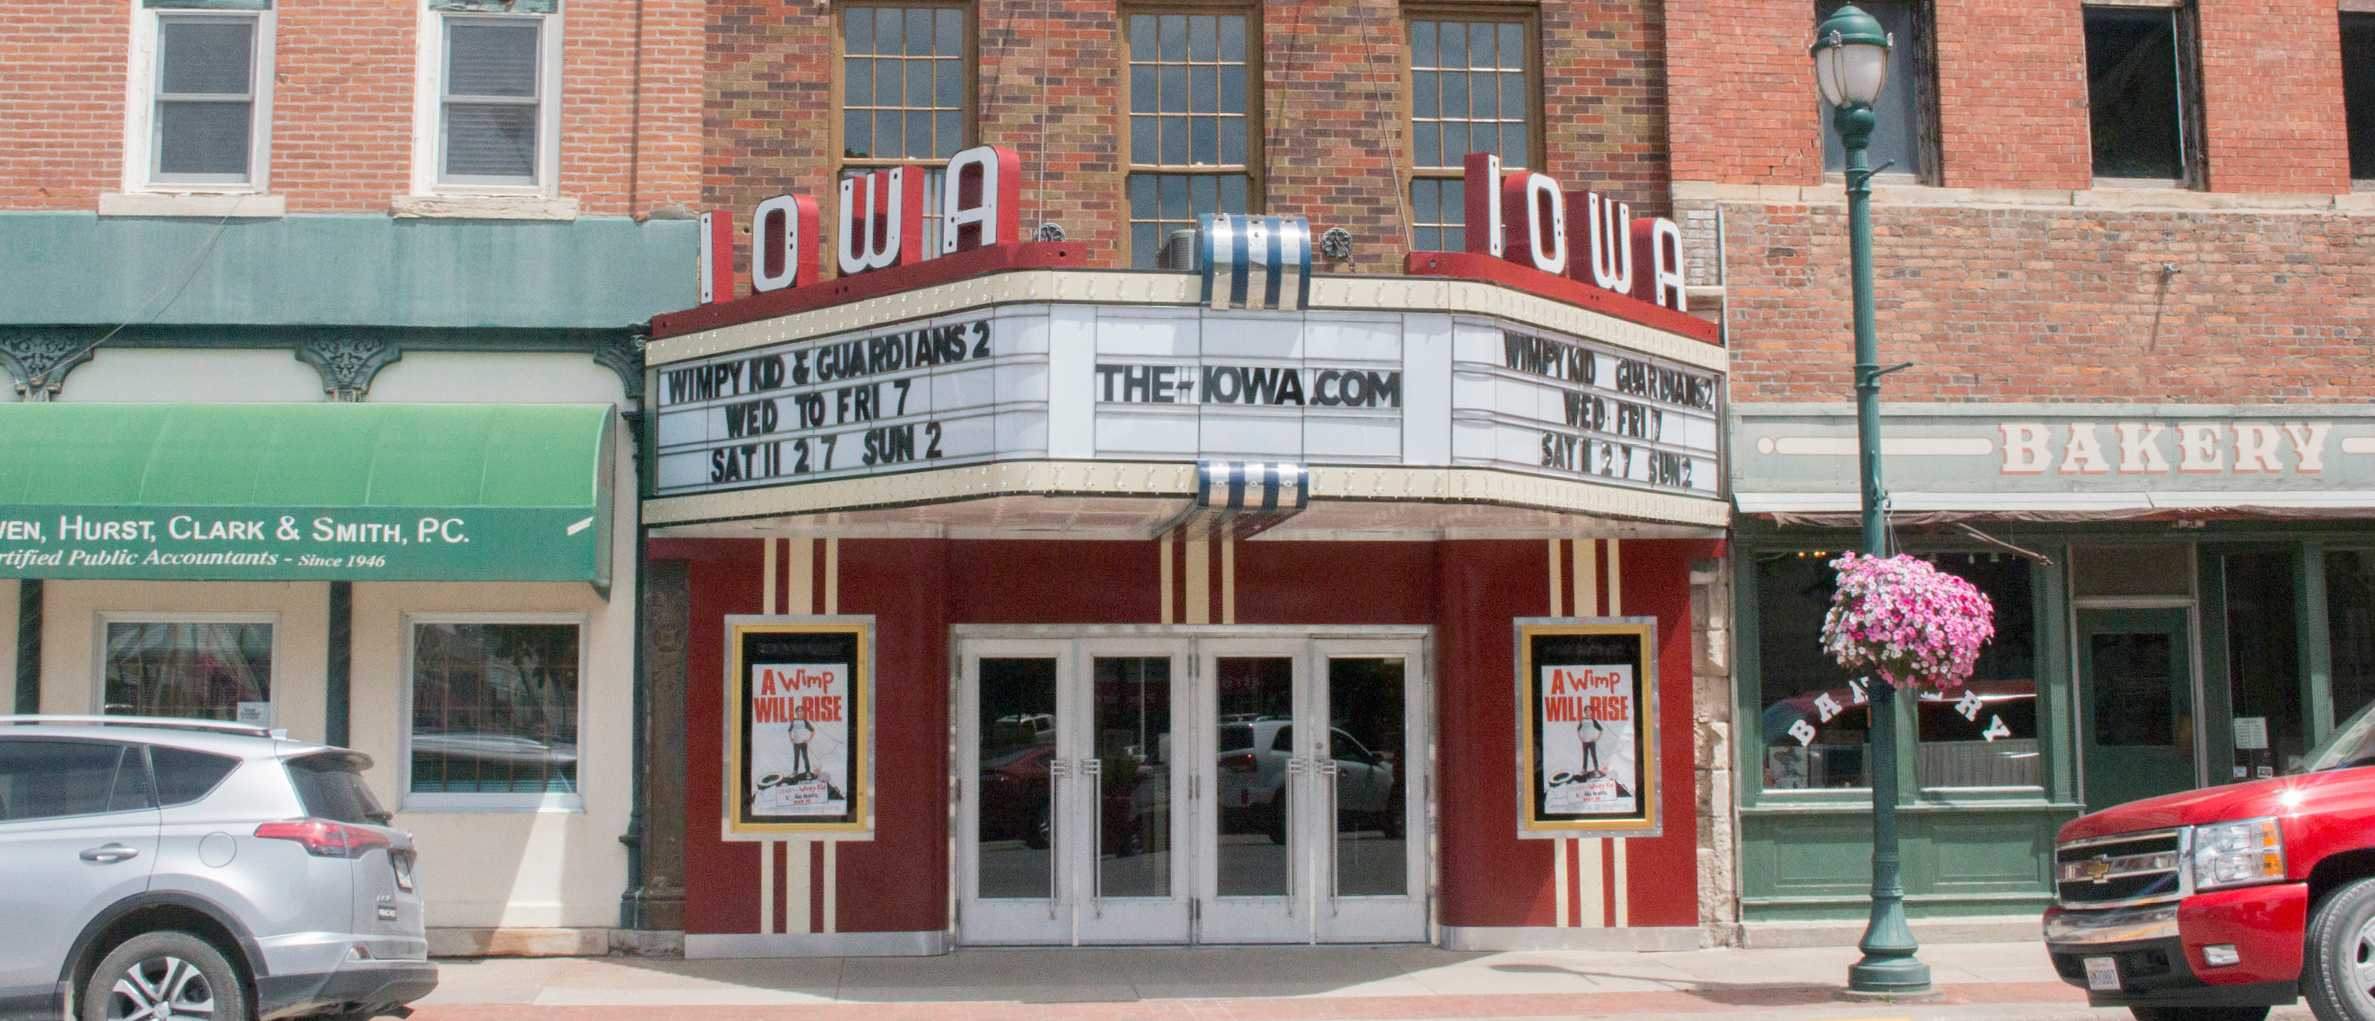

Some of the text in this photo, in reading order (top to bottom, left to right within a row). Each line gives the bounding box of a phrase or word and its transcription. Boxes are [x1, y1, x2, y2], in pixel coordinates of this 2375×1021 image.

[702, 145, 999, 304] IOWA
[1488, 154, 1687, 312] IOWA
[668, 320, 991, 404] WIMPY KID & GUARDIANS 2
[1504, 331, 1568, 378] WIMPY
[1567, 346, 1596, 386] KID
[1616, 358, 1705, 408] GUARDIANS
[725, 399, 779, 438] WED
[837, 382, 880, 424] FRI
[893, 378, 911, 417] 7
[1563, 389, 1662, 441] WED FRI 7
[711, 444, 757, 484] SAT
[793, 437, 810, 474] 2
[820, 434, 838, 471] 7
[862, 422, 915, 466] SUN
[925, 420, 942, 459] 2
[1541, 431, 1577, 471] SAT
[1601, 442, 1613, 477] 2
[1620, 444, 1632, 479] 7
[1648, 450, 1681, 487] SUN
[1681, 456, 1693, 488] 2
[1998, 421, 2332, 475] BAKERY
[0, 515, 470, 546] EN, HURST, CLARK & SMITH, P.C.
[68, 549, 139, 567] Public
[142, 549, 279, 567] Accountants
[298, 554, 343, 567] Since
[346, 555, 386, 568] 1946
[761, 669, 835, 695] A Wimp
[1544, 696, 1629, 722] WILL RISE
[1551, 669, 1621, 695] A Wimp
[753, 696, 842, 723] WILL RISE
